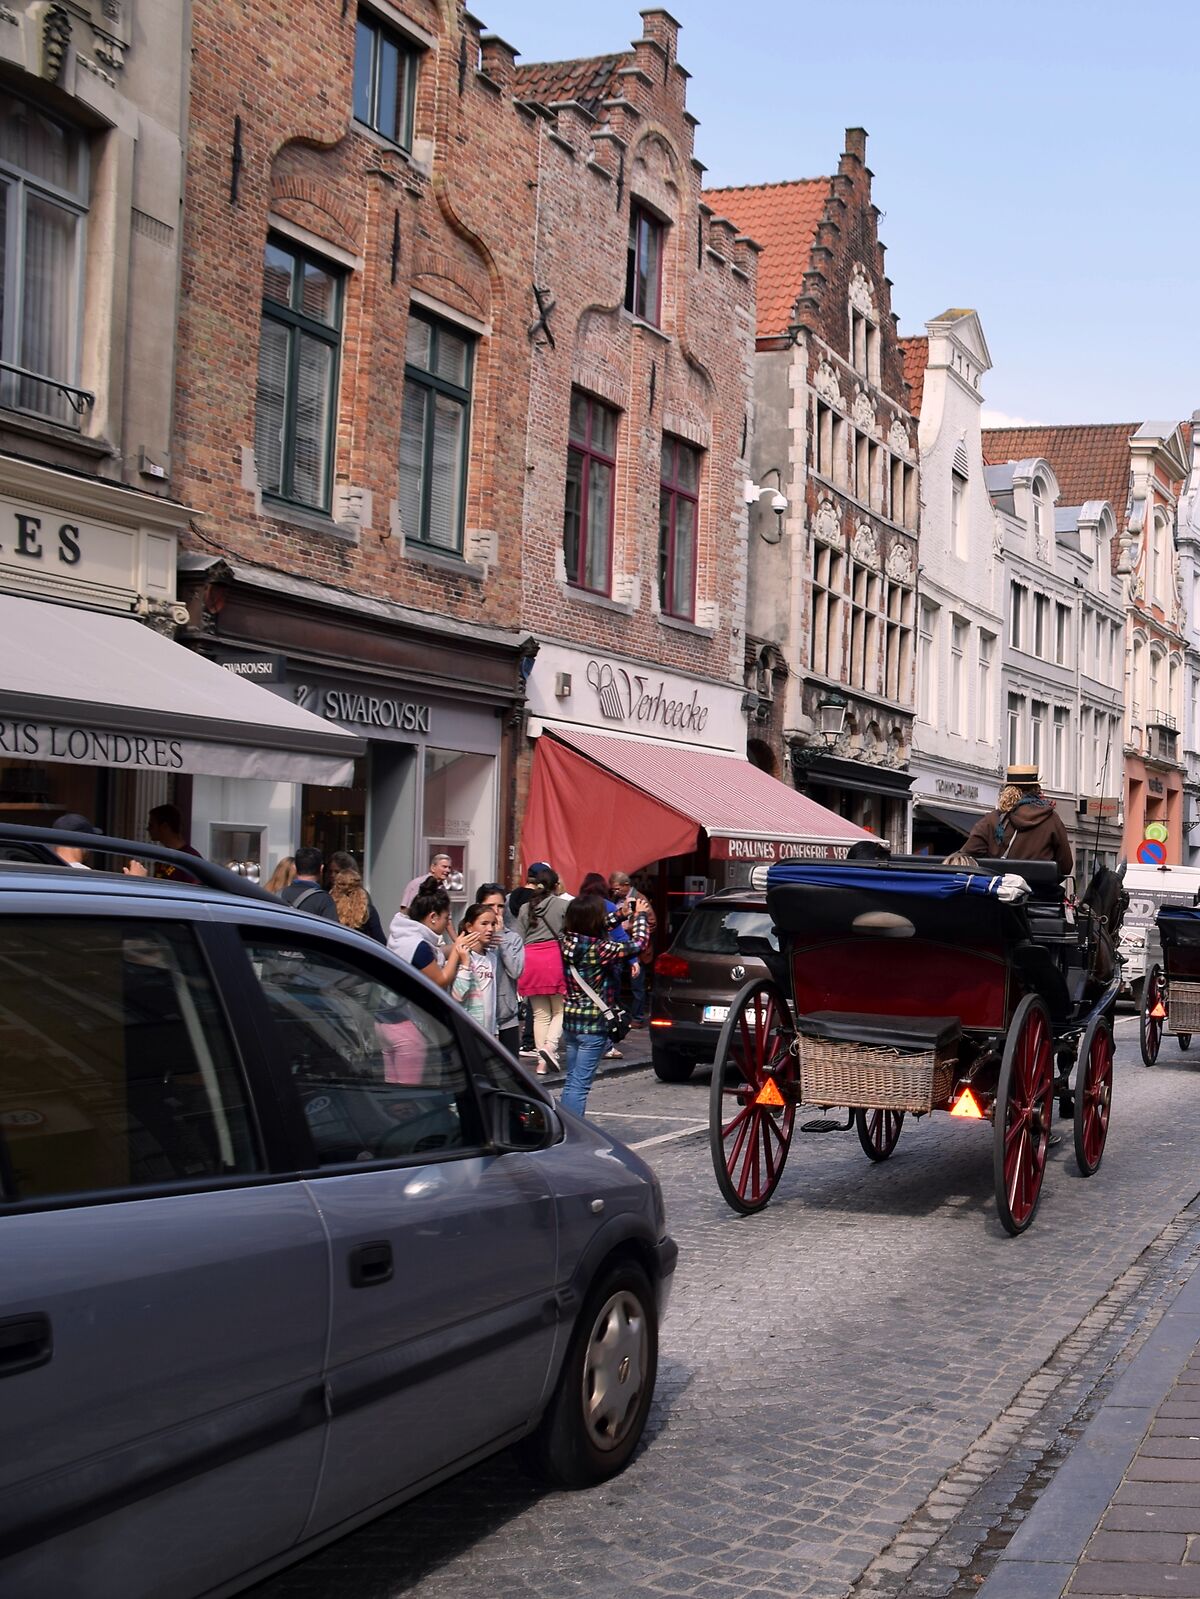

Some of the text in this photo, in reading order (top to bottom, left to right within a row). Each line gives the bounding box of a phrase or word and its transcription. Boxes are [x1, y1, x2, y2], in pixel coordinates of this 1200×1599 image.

[0, 513, 81, 564] ES
[325, 690, 433, 732] SWAROVSKI
[618, 668, 709, 732] Verheecke
[49, 726, 184, 769] LONDRES
[728, 839, 851, 860] PRALINES CONFISERIE VER
